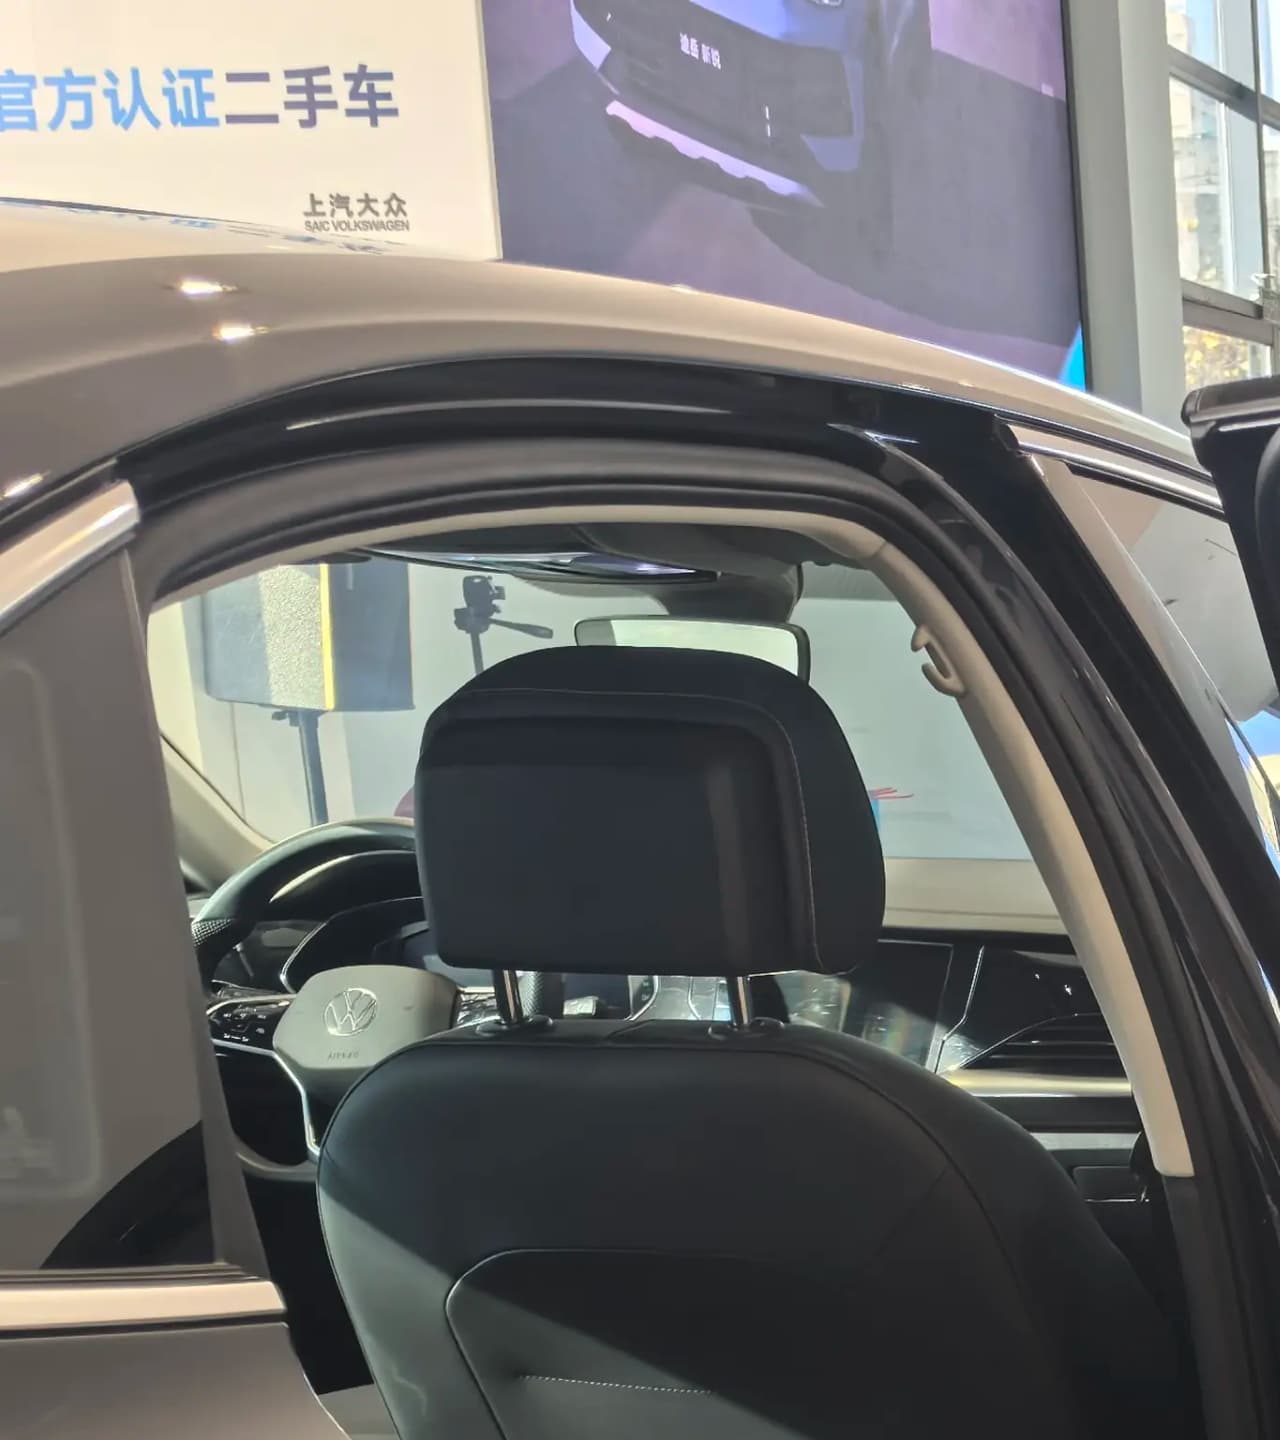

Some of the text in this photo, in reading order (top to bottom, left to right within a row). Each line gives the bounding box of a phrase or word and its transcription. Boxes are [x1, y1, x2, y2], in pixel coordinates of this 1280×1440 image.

[0, 63, 400, 132] 官方认证二手车
[303, 192, 408, 217] 上汽大众
[304, 220, 410, 232] SAIC VOLKSWAGEN
